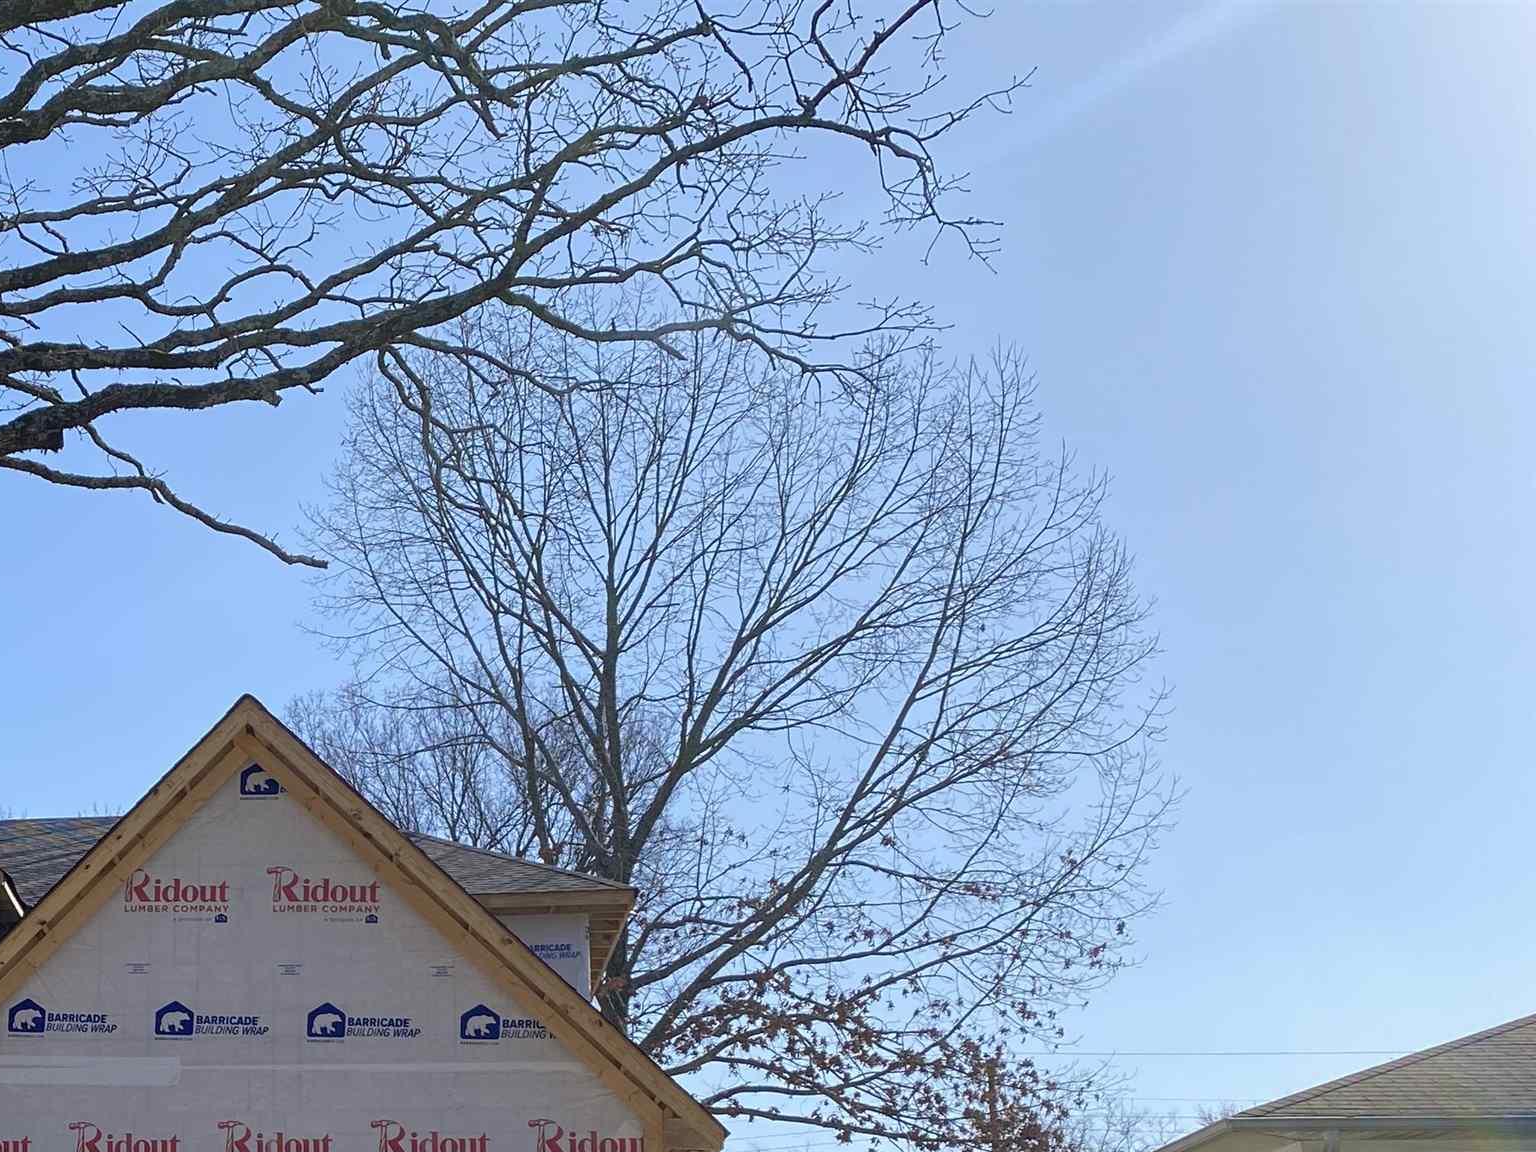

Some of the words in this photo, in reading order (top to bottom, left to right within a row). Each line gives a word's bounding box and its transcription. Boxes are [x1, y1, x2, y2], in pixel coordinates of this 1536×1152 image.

[124, 868, 229, 902] Ridout
[266, 866, 380, 903] Ridout
[124, 905, 168, 913] LUMBER
[173, 904, 229, 913] COMPANY
[272, 905, 318, 913] LUMBER
[322, 904, 380, 913] COMPANY
[47, 1013, 107, 1023] BARRICADE
[195, 1015, 258, 1026] BARRICADE
[347, 1017, 410, 1027] BARRICADE
[46, 1023, 89, 1033] BUILDING
[90, 1024, 118, 1034] WRAP
[502, 1019, 546, 1029] BARRIC
[194, 1025, 240, 1035] BUILDING
[241, 1026, 270, 1036] WRAP
[346, 1027, 391, 1037] BUILDING
[392, 1028, 422, 1039] WRAP
[500, 1029, 547, 1039] BUILDING
